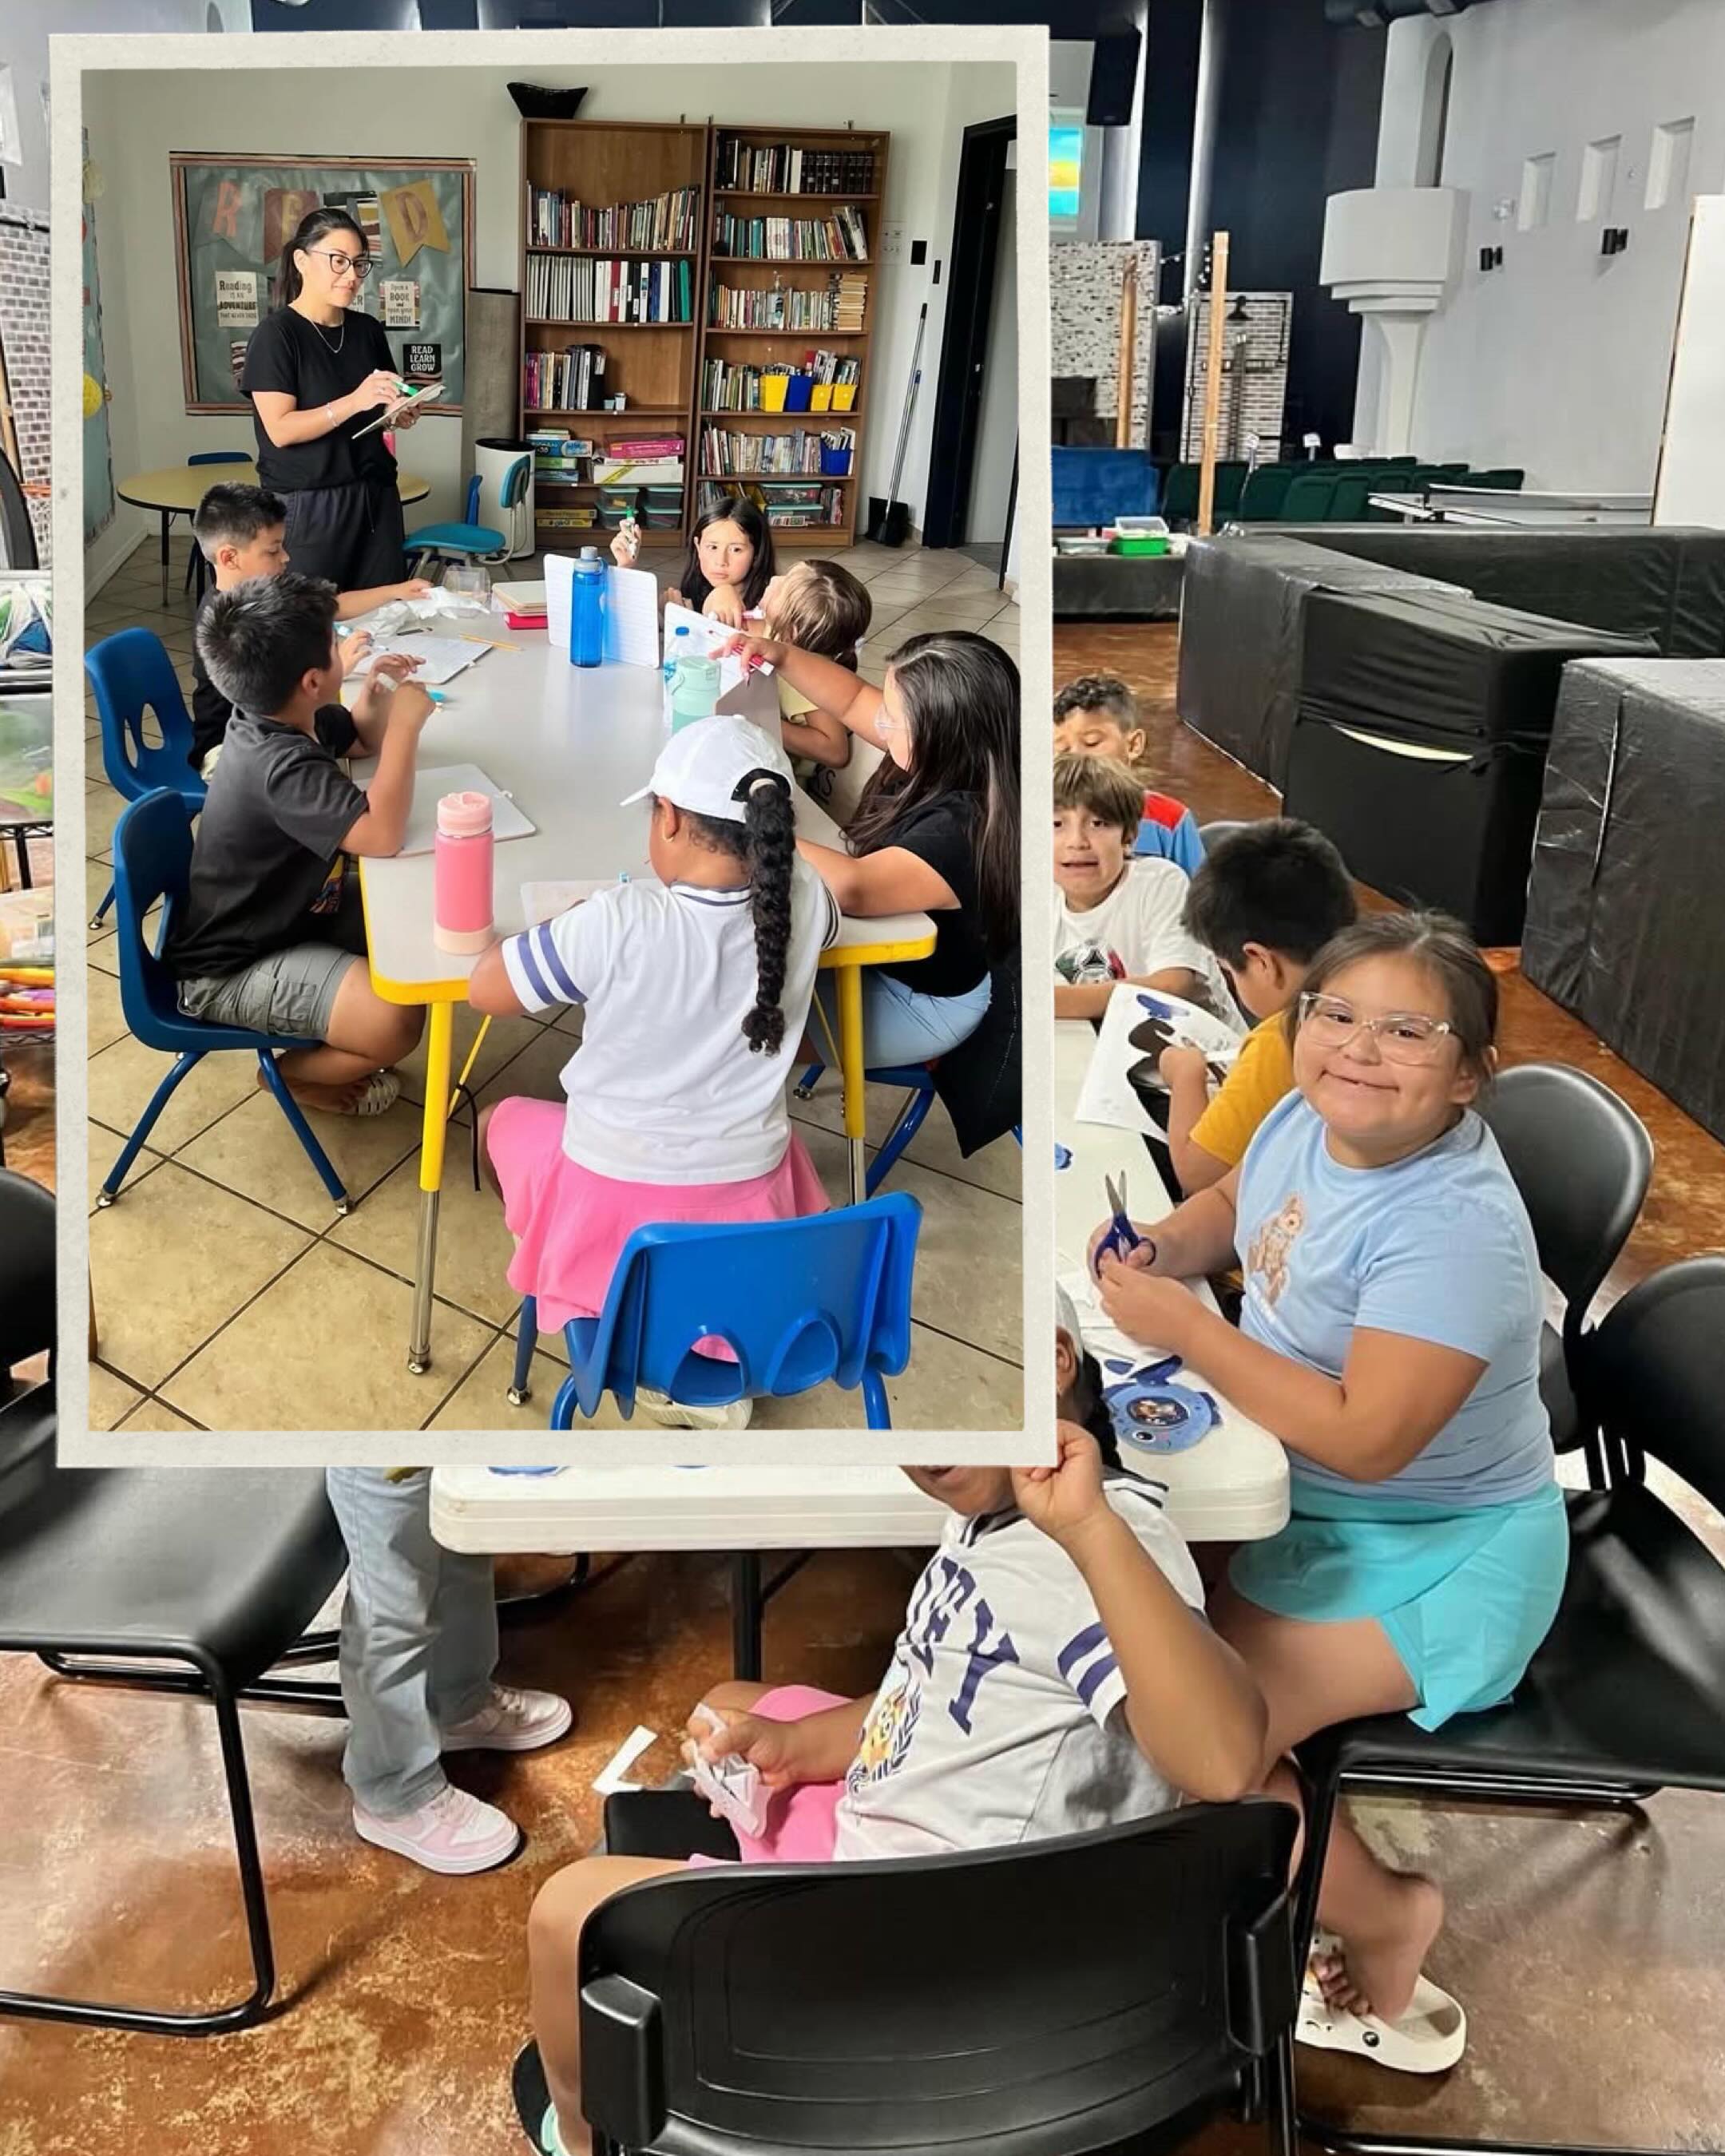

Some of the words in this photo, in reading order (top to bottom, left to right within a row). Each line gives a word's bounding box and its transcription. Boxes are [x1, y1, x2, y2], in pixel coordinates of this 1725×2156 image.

[220, 280, 252, 294] Reading
[390, 292, 410, 301] BOOK
[219, 300, 256, 310] ADVENTURE
[410, 345, 434, 354] READ
[410, 354, 436, 363] LEARN
[410, 363, 434, 372] GROW
